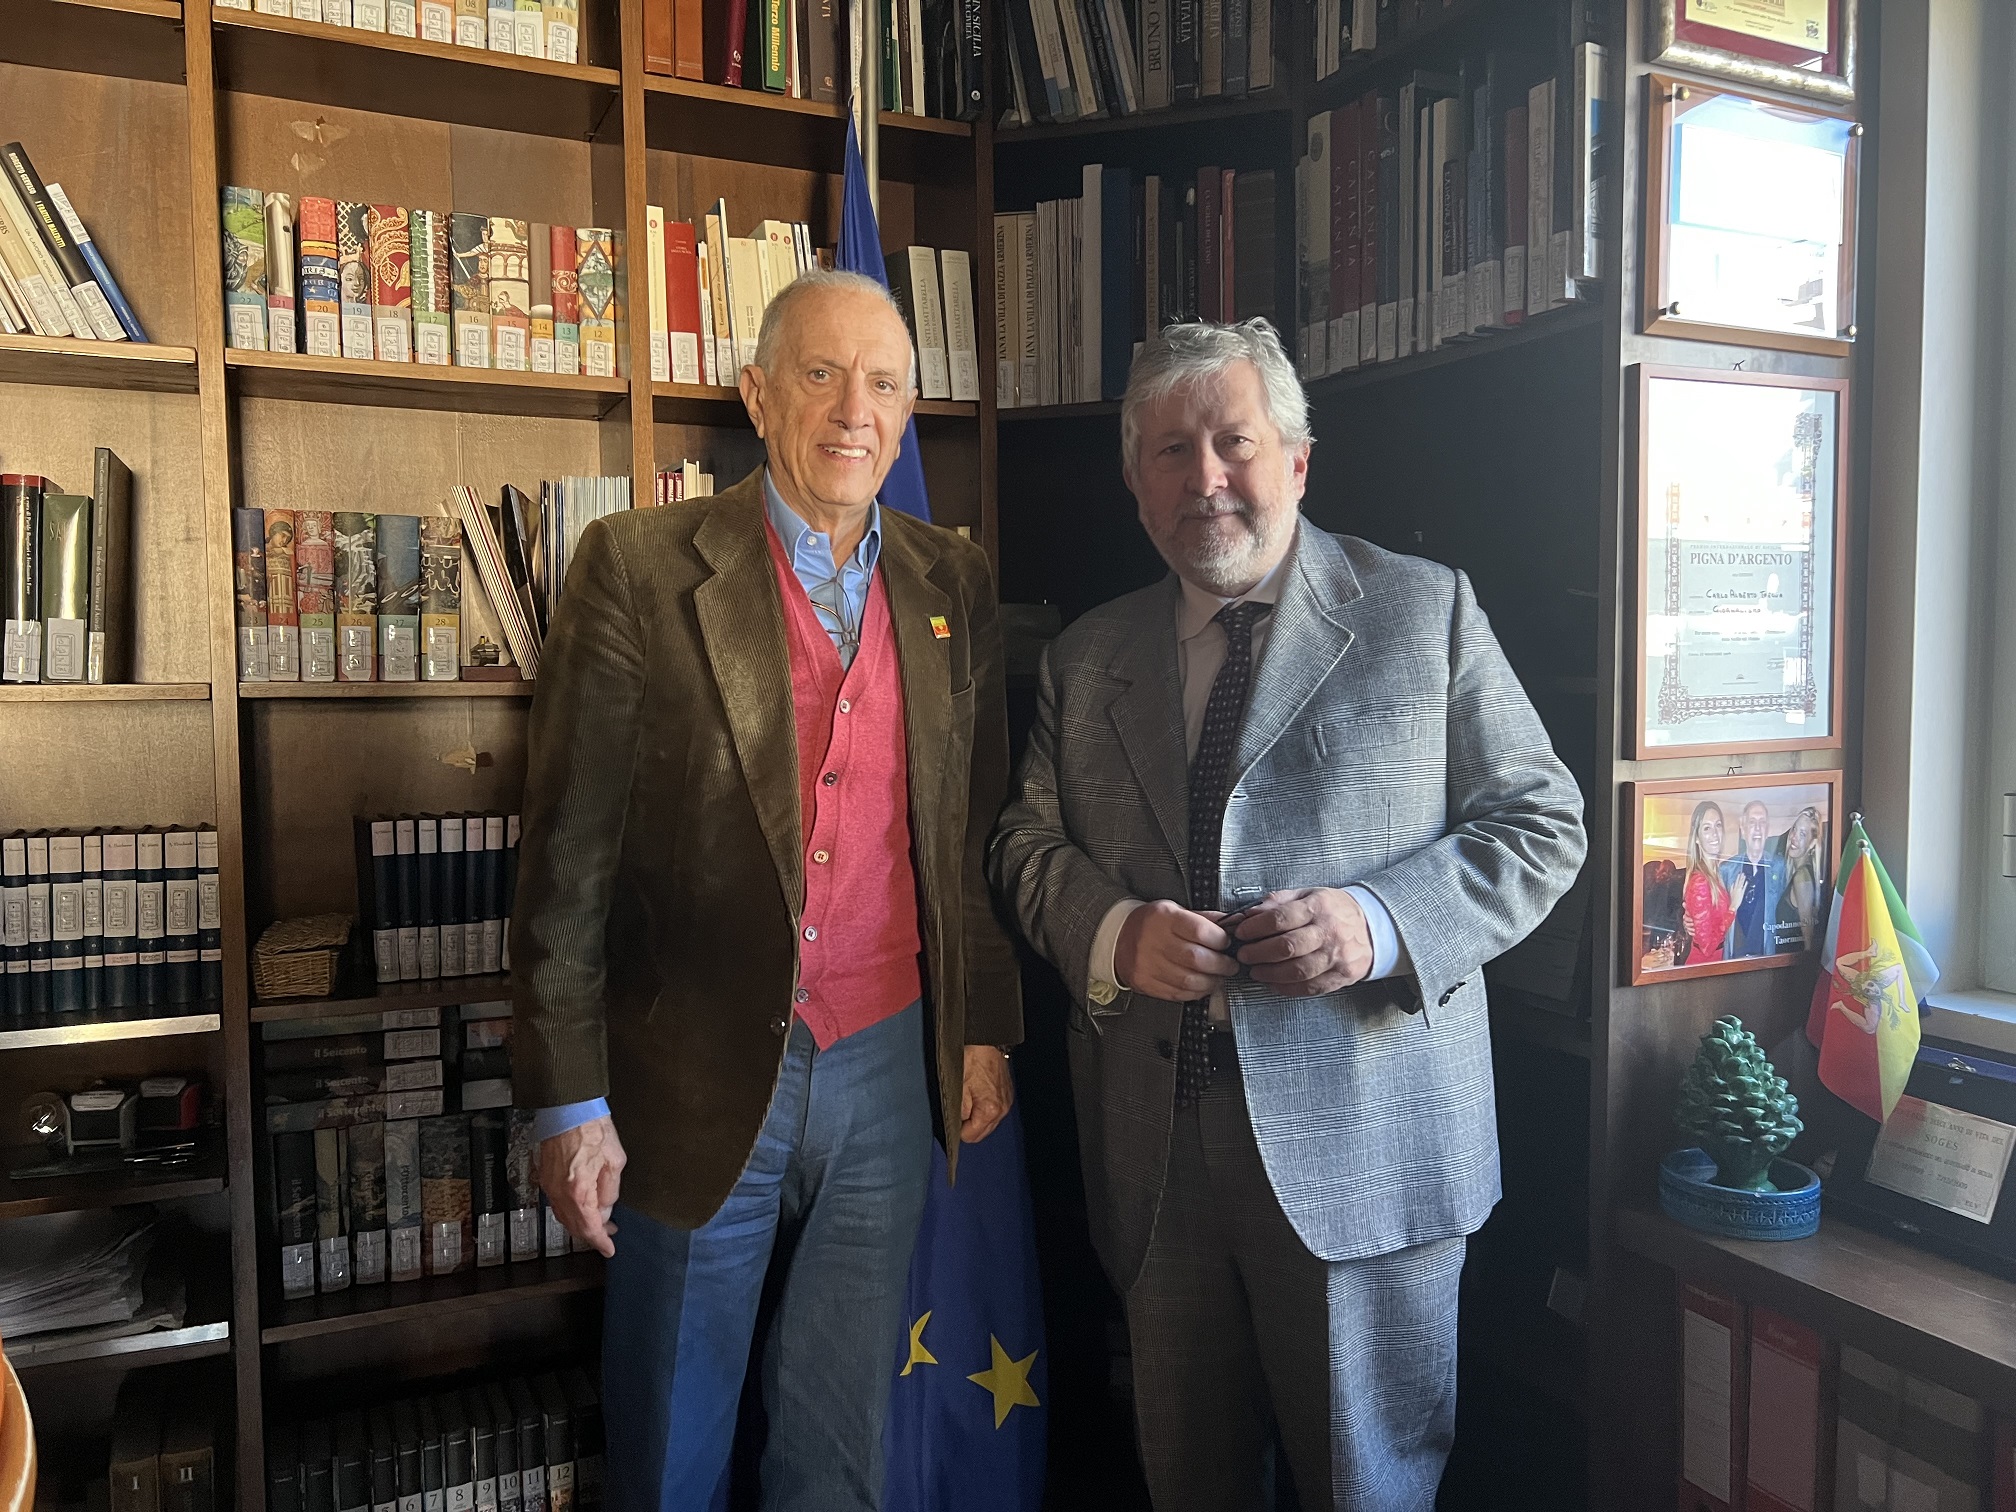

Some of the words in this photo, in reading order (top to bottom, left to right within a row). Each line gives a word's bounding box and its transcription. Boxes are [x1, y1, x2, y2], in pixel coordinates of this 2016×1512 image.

[771, 0, 781, 25] Terzo
[971, 14, 982, 57] SICILIA
[1147, 10, 1161, 72] BRUNO
[771, 27, 781, 73] Millennio
[8, 152, 25, 174] ROBERTO
[20, 174, 36, 195] GERVASO
[1348, 160, 1357, 267] CATANIA
[1367, 150, 1376, 266] CATANIA
[1333, 165, 1342, 272] CATANIA
[996, 225, 1005, 264] ARMERINA
[1025, 223, 1034, 263] ARMERINA
[997, 264, 1005, 290] PIAZZA
[1026, 264, 1034, 290] PIAZZA
[998, 290, 1005, 299] DI
[1026, 290, 1034, 299] DI
[317, 305, 328, 313] 20
[920, 278, 930, 328] MATTARELLA
[952, 281, 962, 332] MATTARELLA
[998, 300, 1006, 323] VILLA
[1026, 301, 1034, 324] VILLA
[998, 324, 1006, 334] LA
[1026, 324, 1034, 334] LA
[1690, 552, 1724, 565] PIGNA
[1728, 553, 1792, 566] D'ARGENTO
[1706, 588, 1728, 599] CARLO
[1730, 588, 1758, 599] ALBERTO
[312, 618, 323, 626] 25
[351, 618, 362, 626] 26
[435, 618, 446, 626] 28
[1762, 920, 1800, 934] Capodanno
[323, 1046, 368, 1058] Seicento
[324, 1076, 369, 1088] Seicento
[1924, 1134, 1958, 1150] SOGES
[400, 1164, 410, 1216] l'Ottocento
[484, 1160, 494, 1210] Novecento
[179, 1467, 194, 1482] II
[526, 1472, 540, 1485] 11
[556, 1466, 570, 1480] 12
[482, 1482, 492, 1494] 9
[502, 1476, 518, 1490] 10
[429, 1494, 438, 1507] 7
[456, 1488, 464, 1501] 8
[406, 1498, 414, 1512] 6
